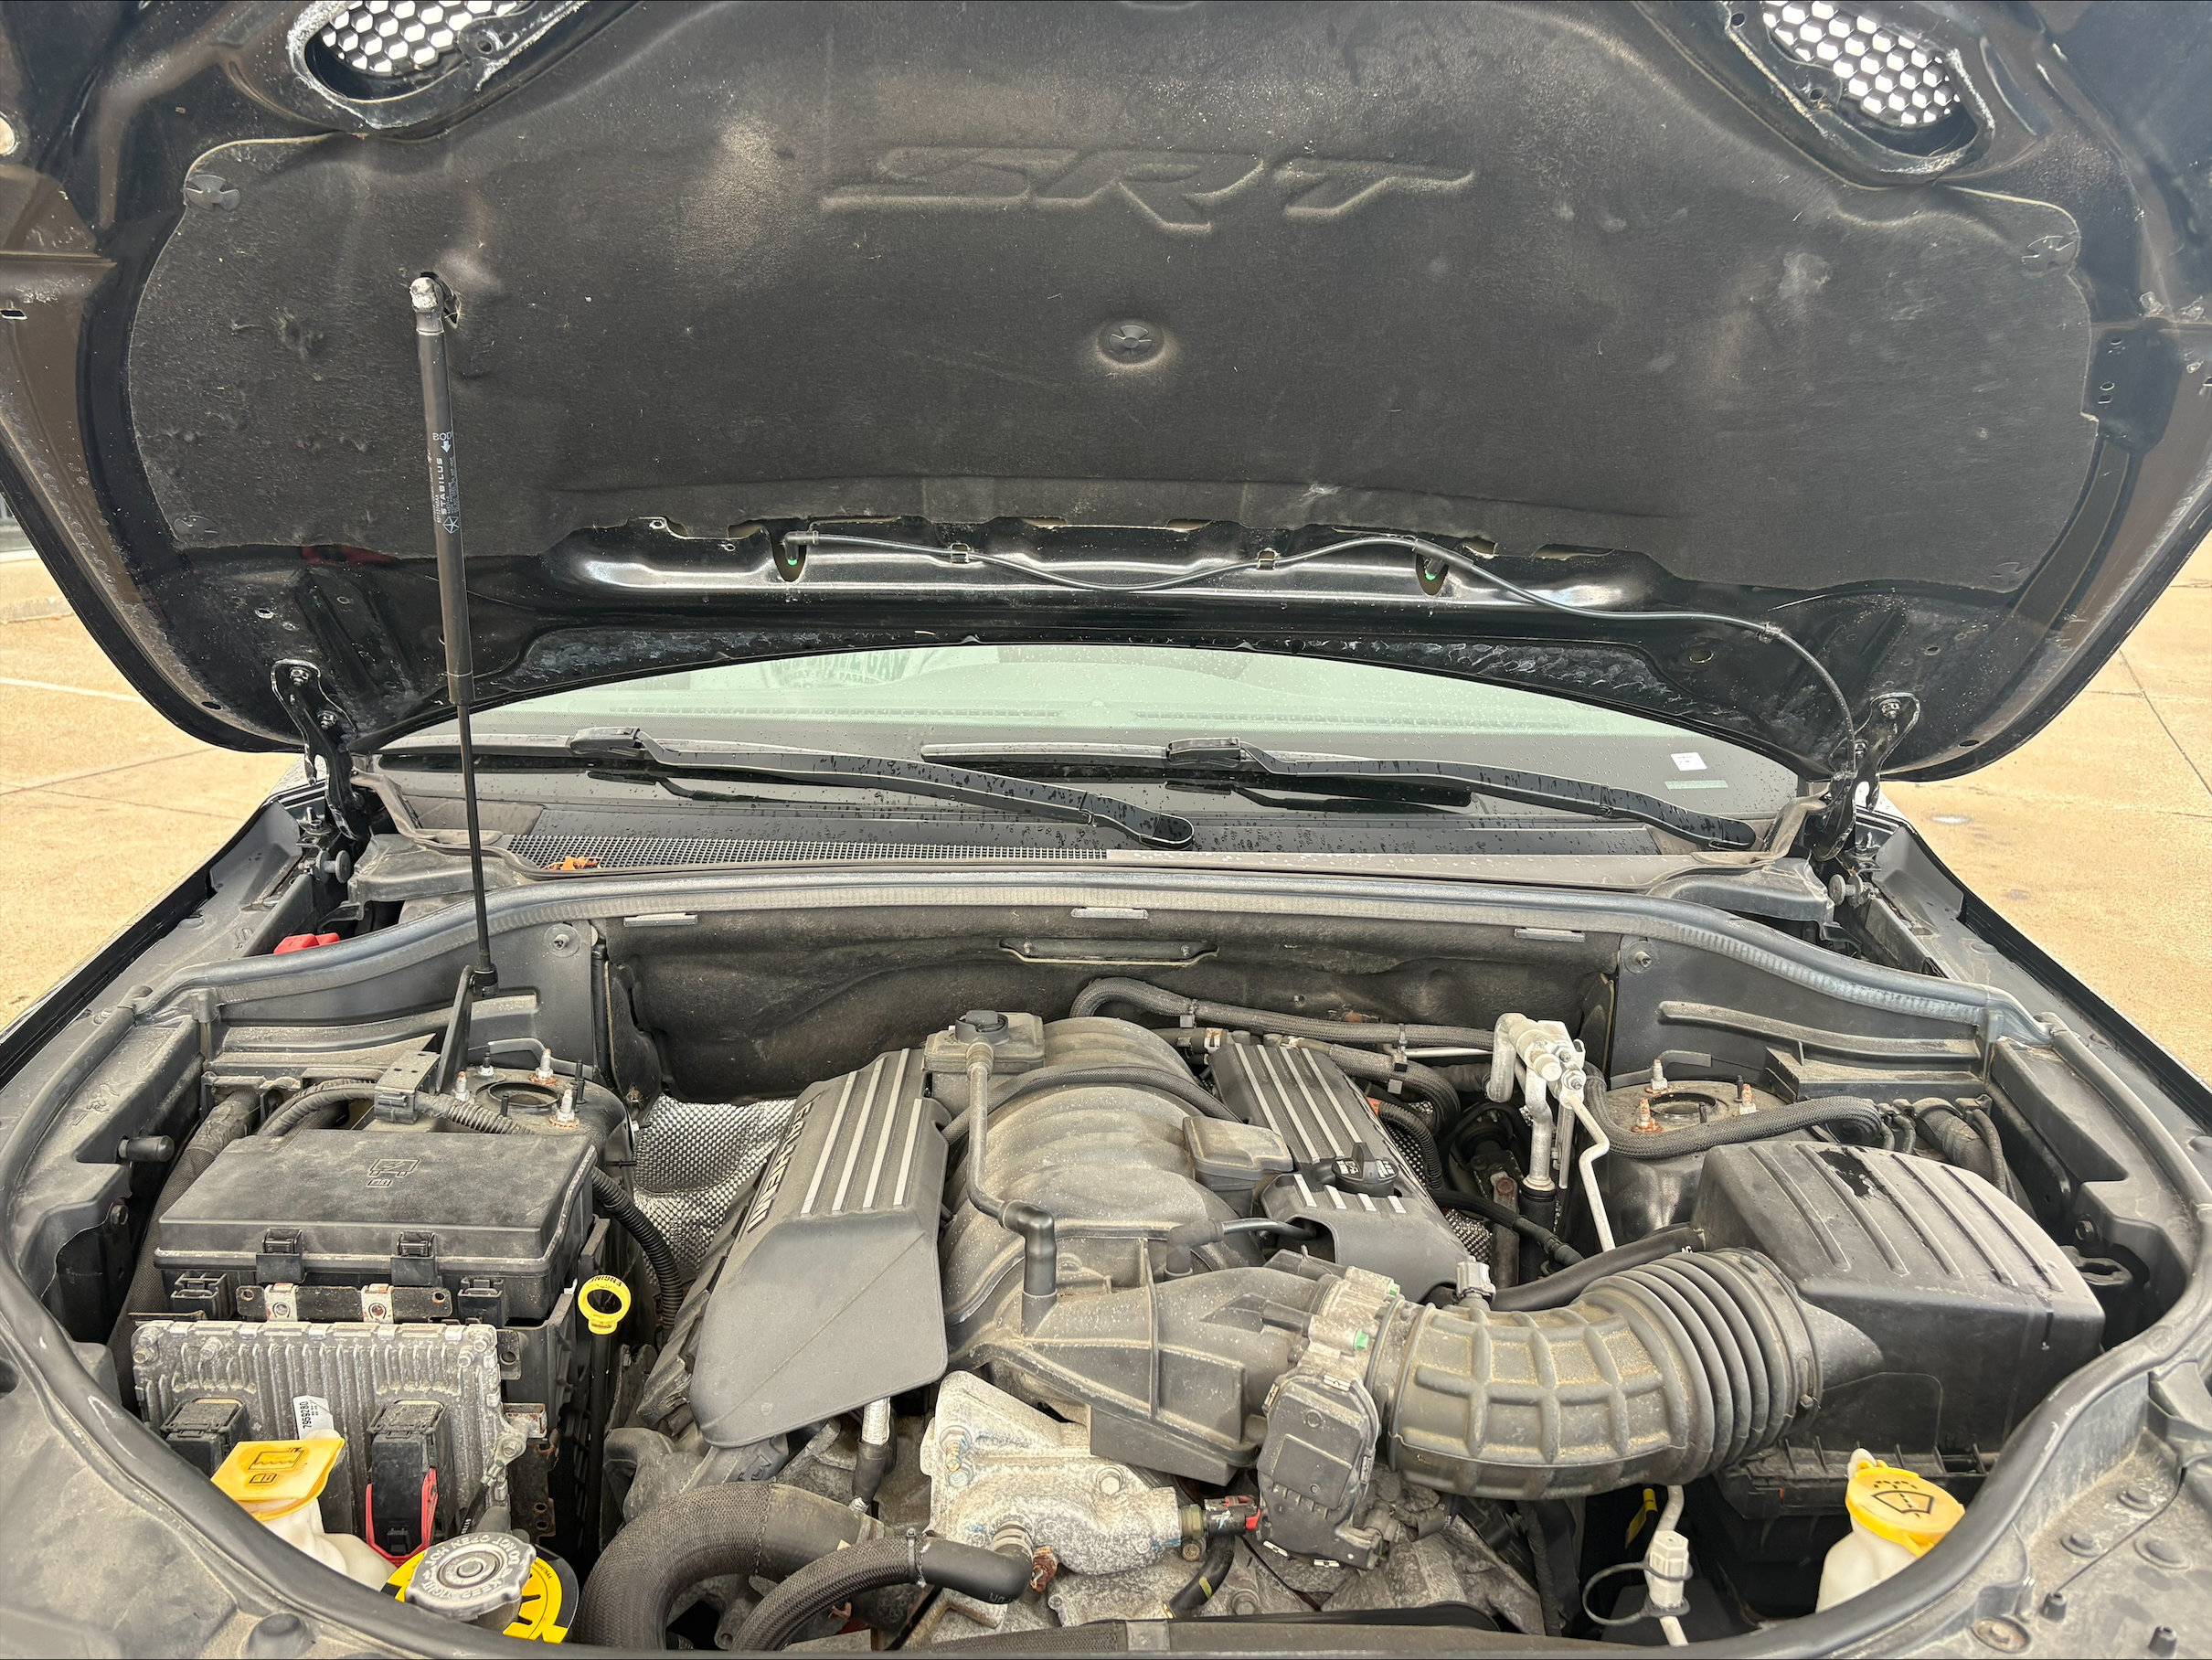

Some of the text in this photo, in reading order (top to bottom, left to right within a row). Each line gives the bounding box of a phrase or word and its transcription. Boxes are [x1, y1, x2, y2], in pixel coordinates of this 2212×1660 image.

[820, 146, 1475, 234] SRT
[432, 431, 452, 441] BOD
[437, 458, 447, 515] STABILUS
[747, 1144, 796, 1233] HEMI
[425, 1534, 520, 1566] DO NOT OPEN HOT
[461, 1579, 503, 1599] KEEP
